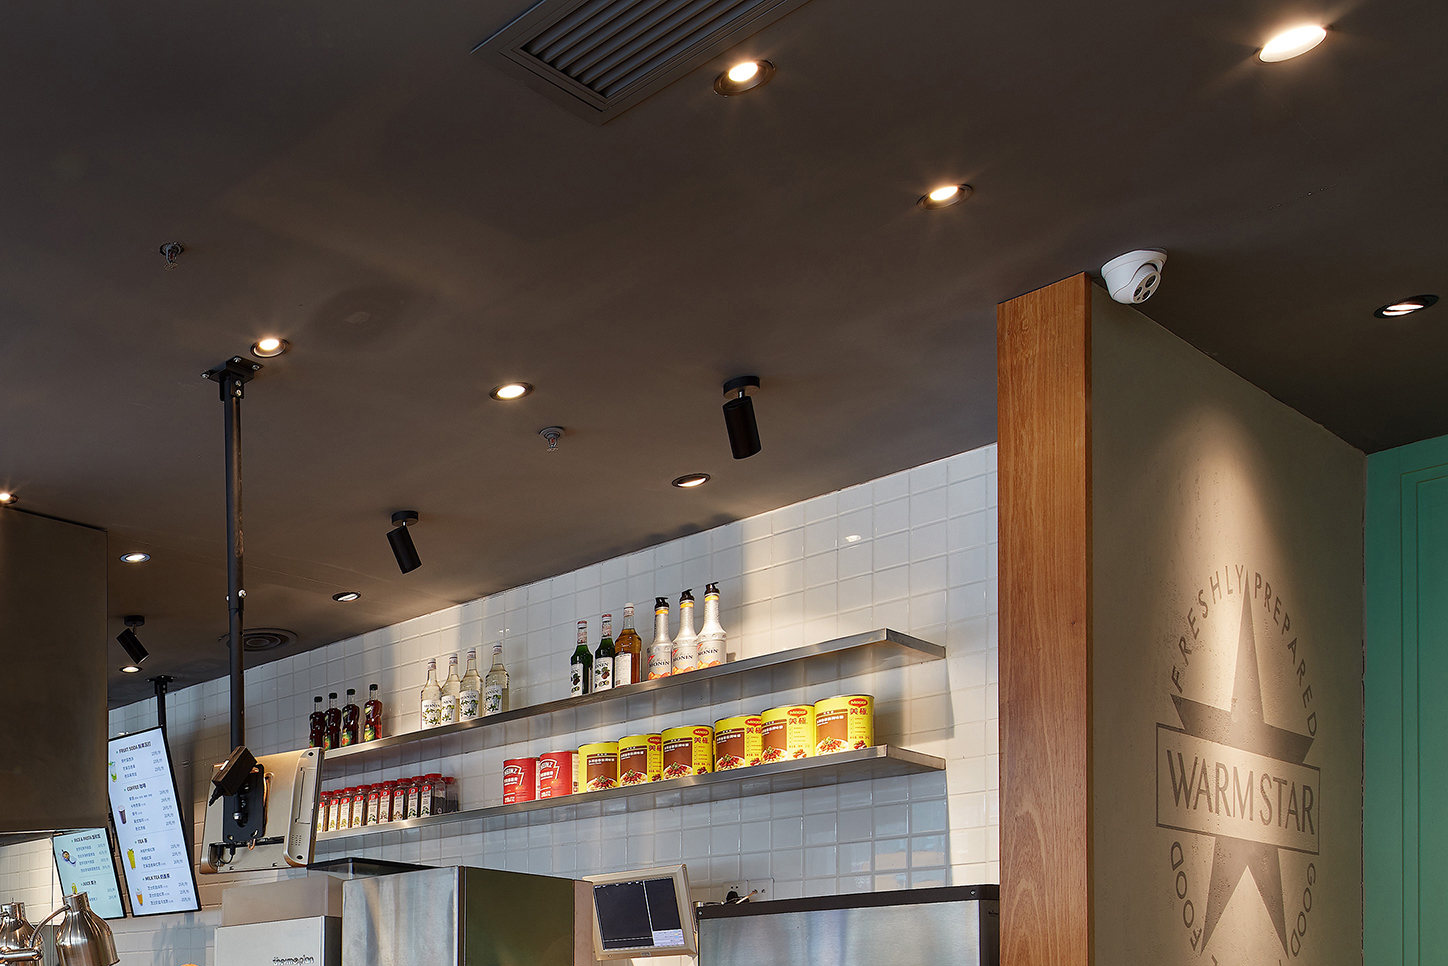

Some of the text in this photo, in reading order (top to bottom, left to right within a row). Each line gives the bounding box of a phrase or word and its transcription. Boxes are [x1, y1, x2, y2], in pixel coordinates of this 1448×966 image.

[1169, 564, 1318, 738] FRESHLY PREPARED
[1170, 840, 1202, 952] FOOD
[1290, 862, 1317, 958] GOOD
